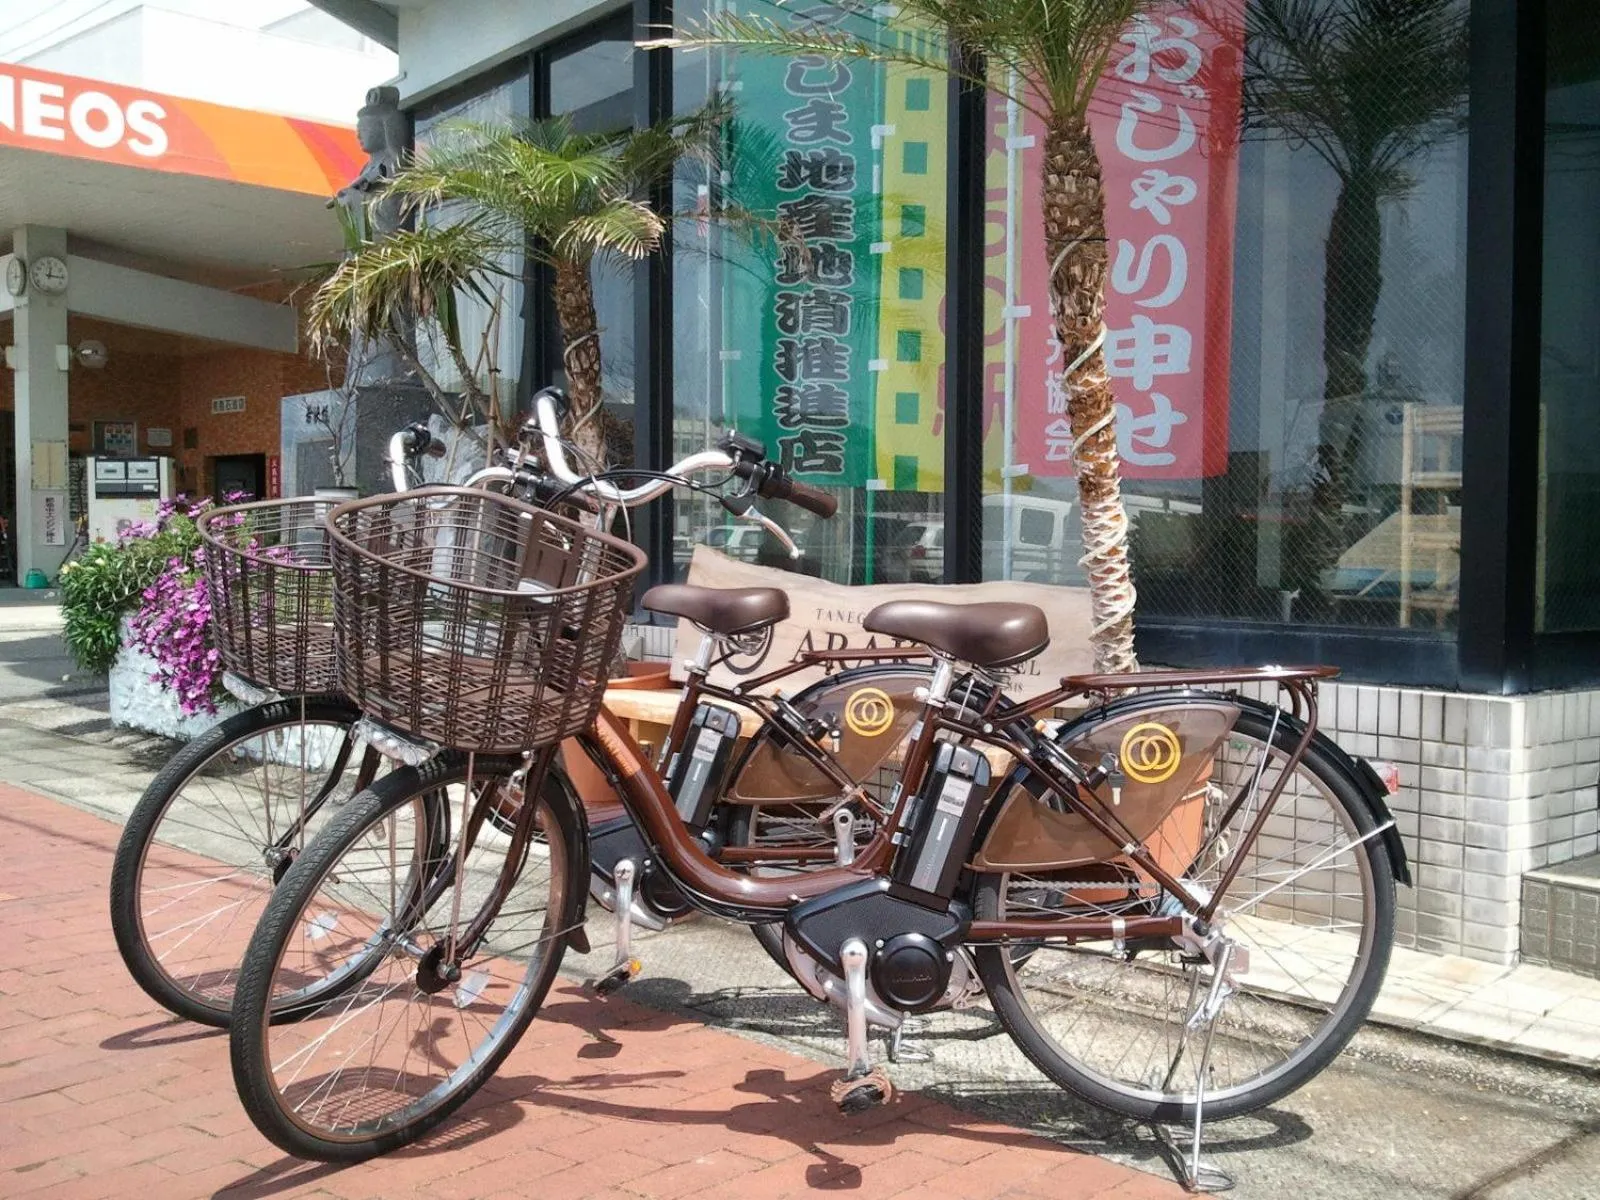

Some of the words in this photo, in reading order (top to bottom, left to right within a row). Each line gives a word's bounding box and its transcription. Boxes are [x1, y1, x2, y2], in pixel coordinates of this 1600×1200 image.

[1103, 13, 1205, 467] おじゃり申せ
